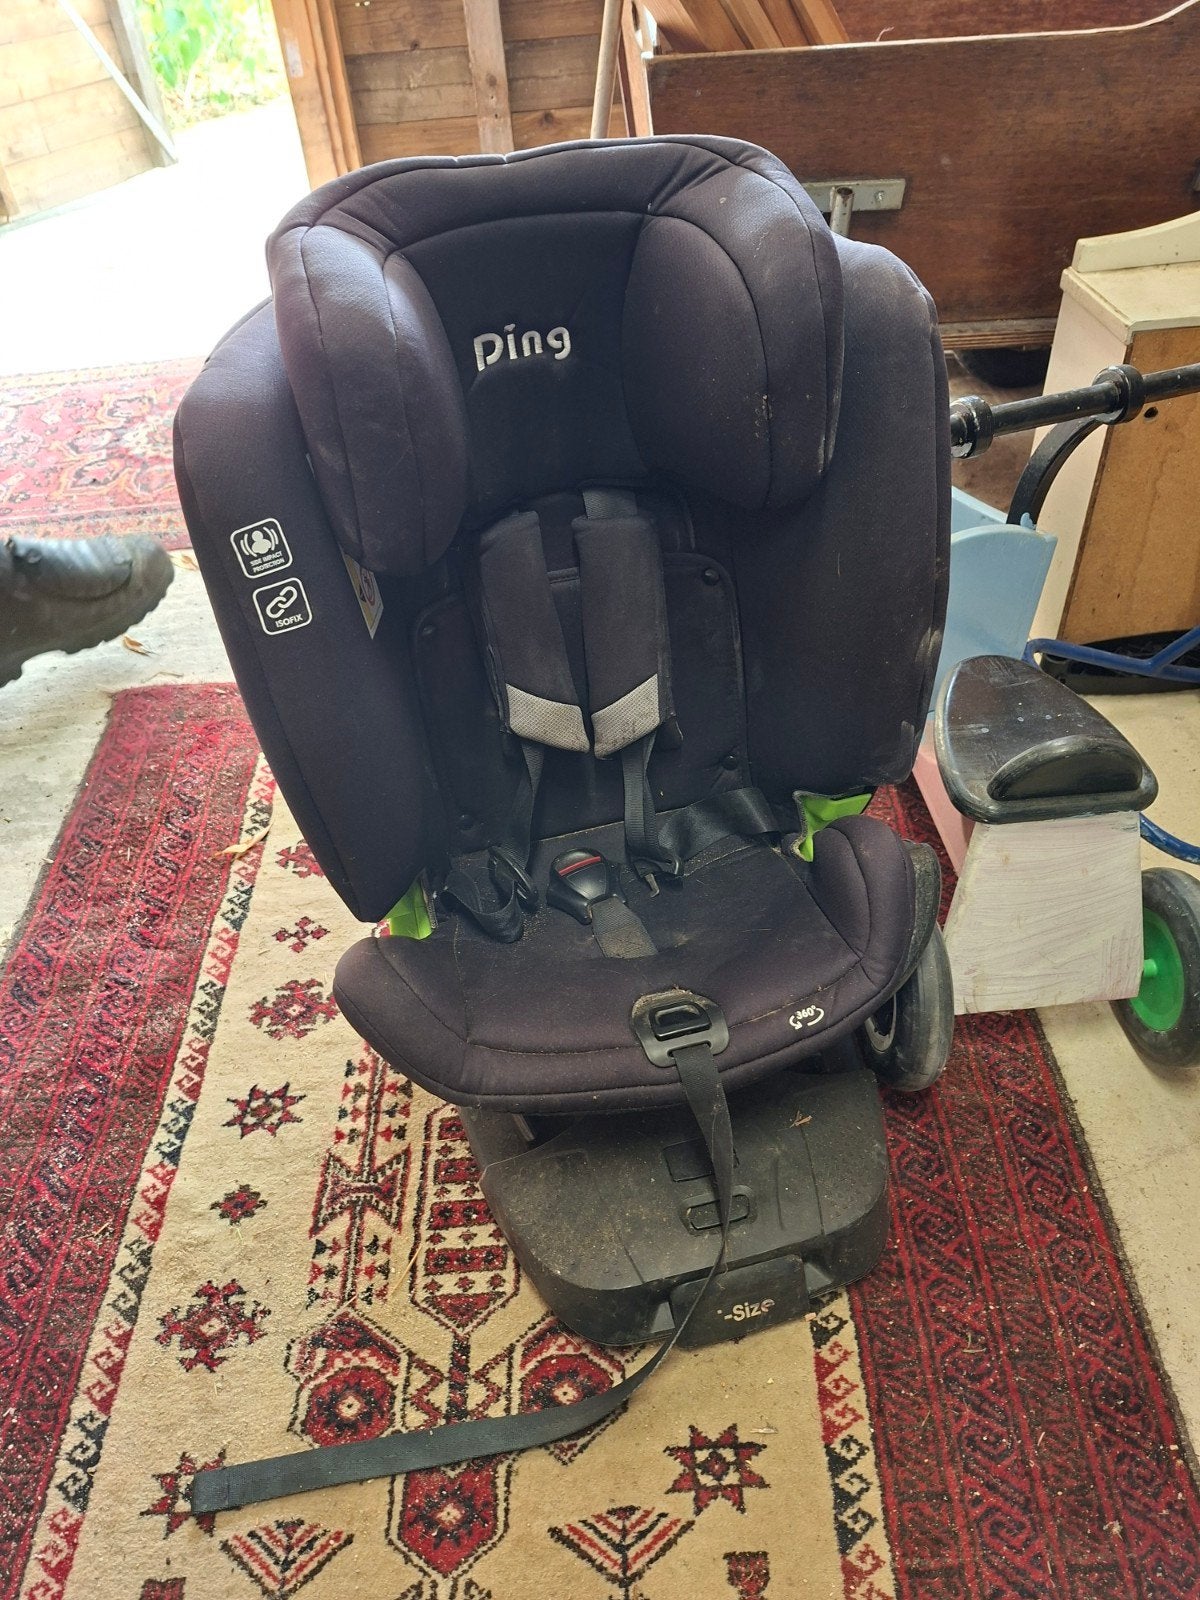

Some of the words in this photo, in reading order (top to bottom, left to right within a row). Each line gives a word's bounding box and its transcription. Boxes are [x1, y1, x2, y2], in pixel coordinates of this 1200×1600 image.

[473, 323, 571, 372] Ping
[250, 558, 262, 567] SIDE
[262, 550, 283, 562] IMPACT
[252, 557, 286, 573] PROTECTION
[275, 613, 304, 628] ISOFIX
